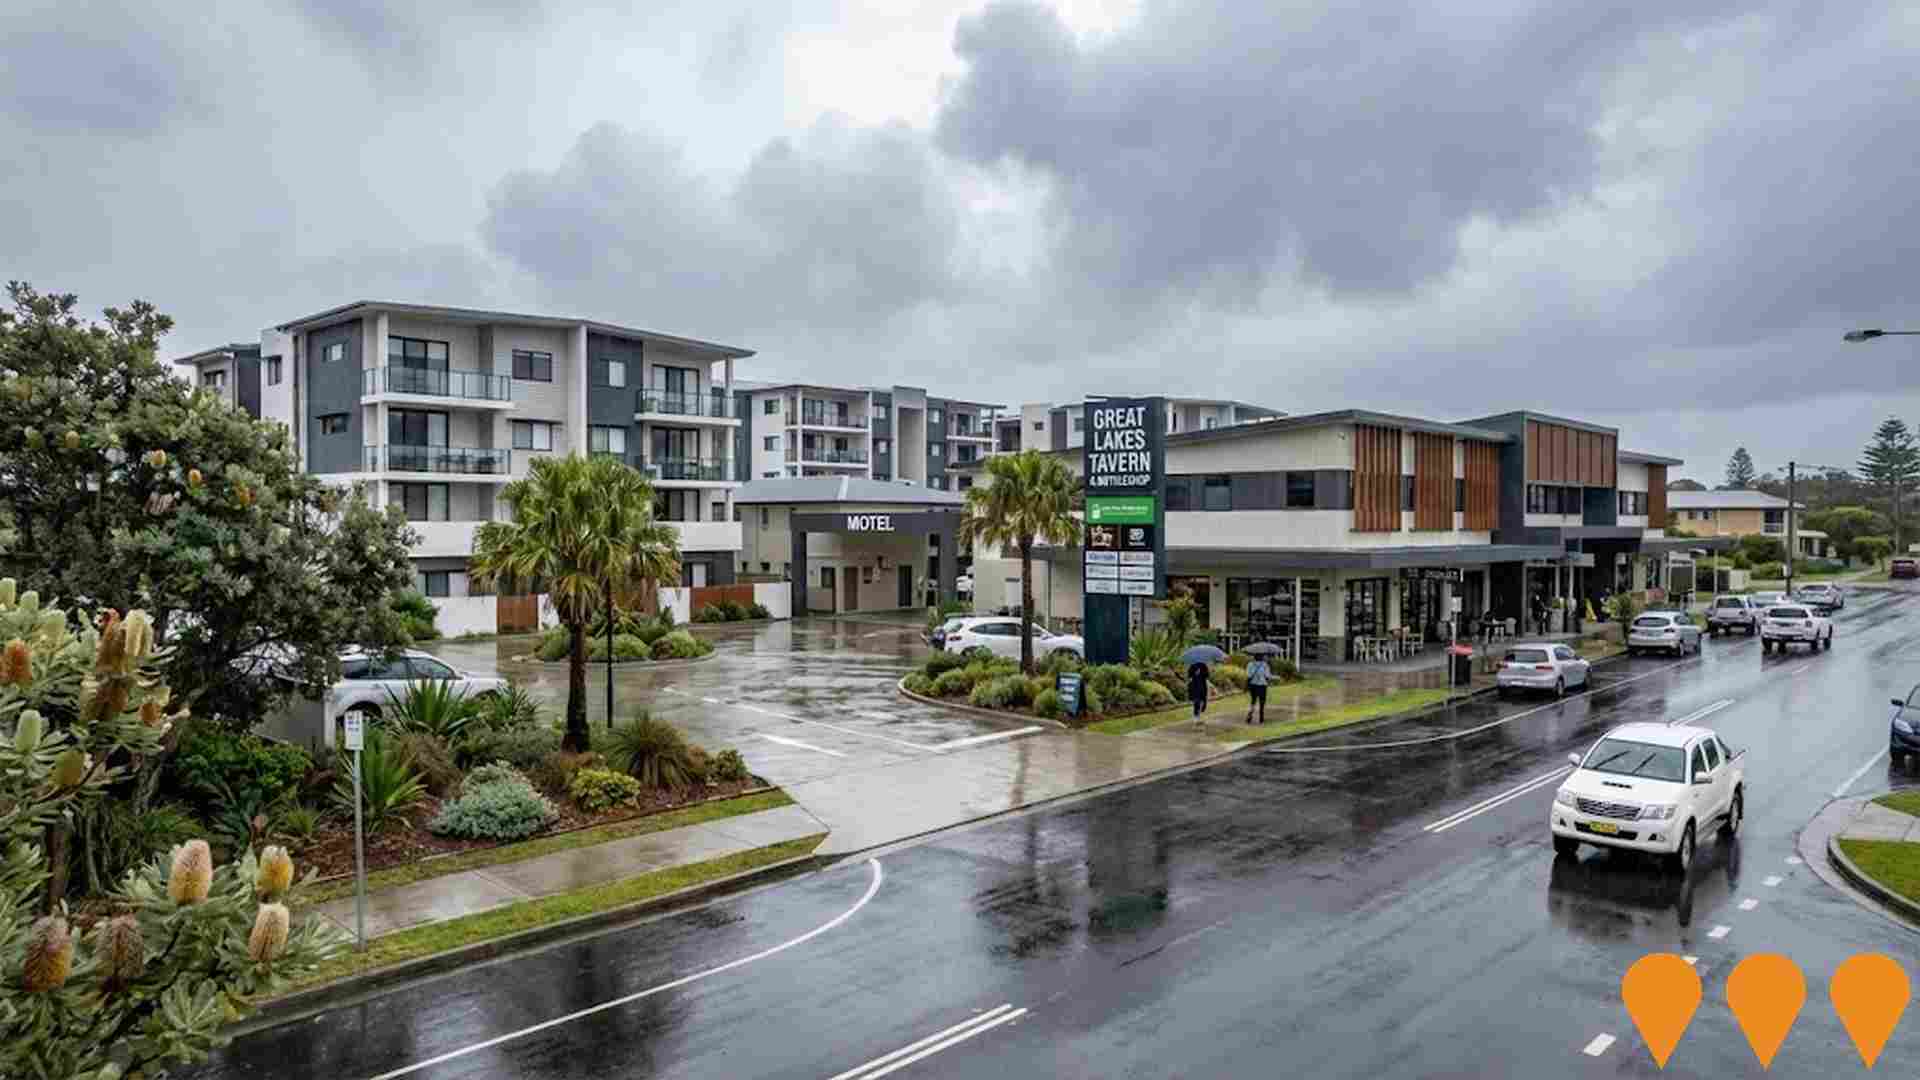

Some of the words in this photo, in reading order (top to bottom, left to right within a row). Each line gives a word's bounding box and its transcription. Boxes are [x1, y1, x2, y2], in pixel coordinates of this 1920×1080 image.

[1093, 407, 1145, 429] GREAT
[1094, 429, 1146, 450] LAKES
[1088, 451, 1151, 473] TAVERN
[847, 515, 895, 531] MOTEL
